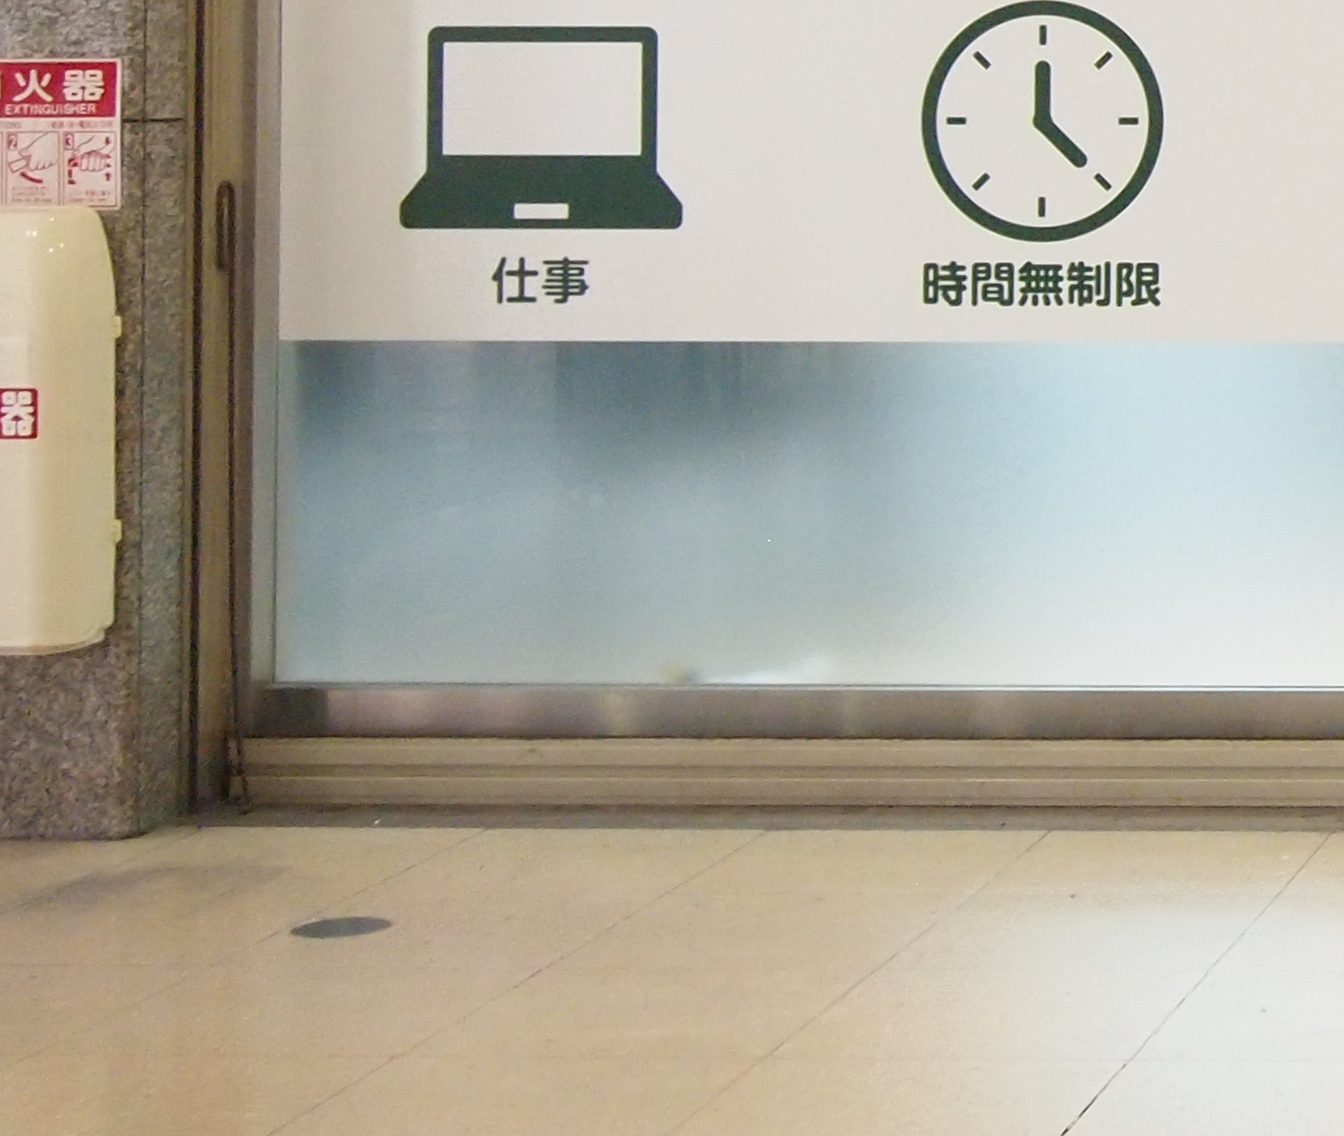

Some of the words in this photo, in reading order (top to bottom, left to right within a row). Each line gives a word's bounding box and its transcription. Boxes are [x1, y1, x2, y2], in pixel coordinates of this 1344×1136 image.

[0, 69, 105, 102] 火器
[4, 103, 97, 115] EXTINGUISHER
[491, 256, 590, 305] 仕事
[922, 260, 1161, 308] 時間無制限
